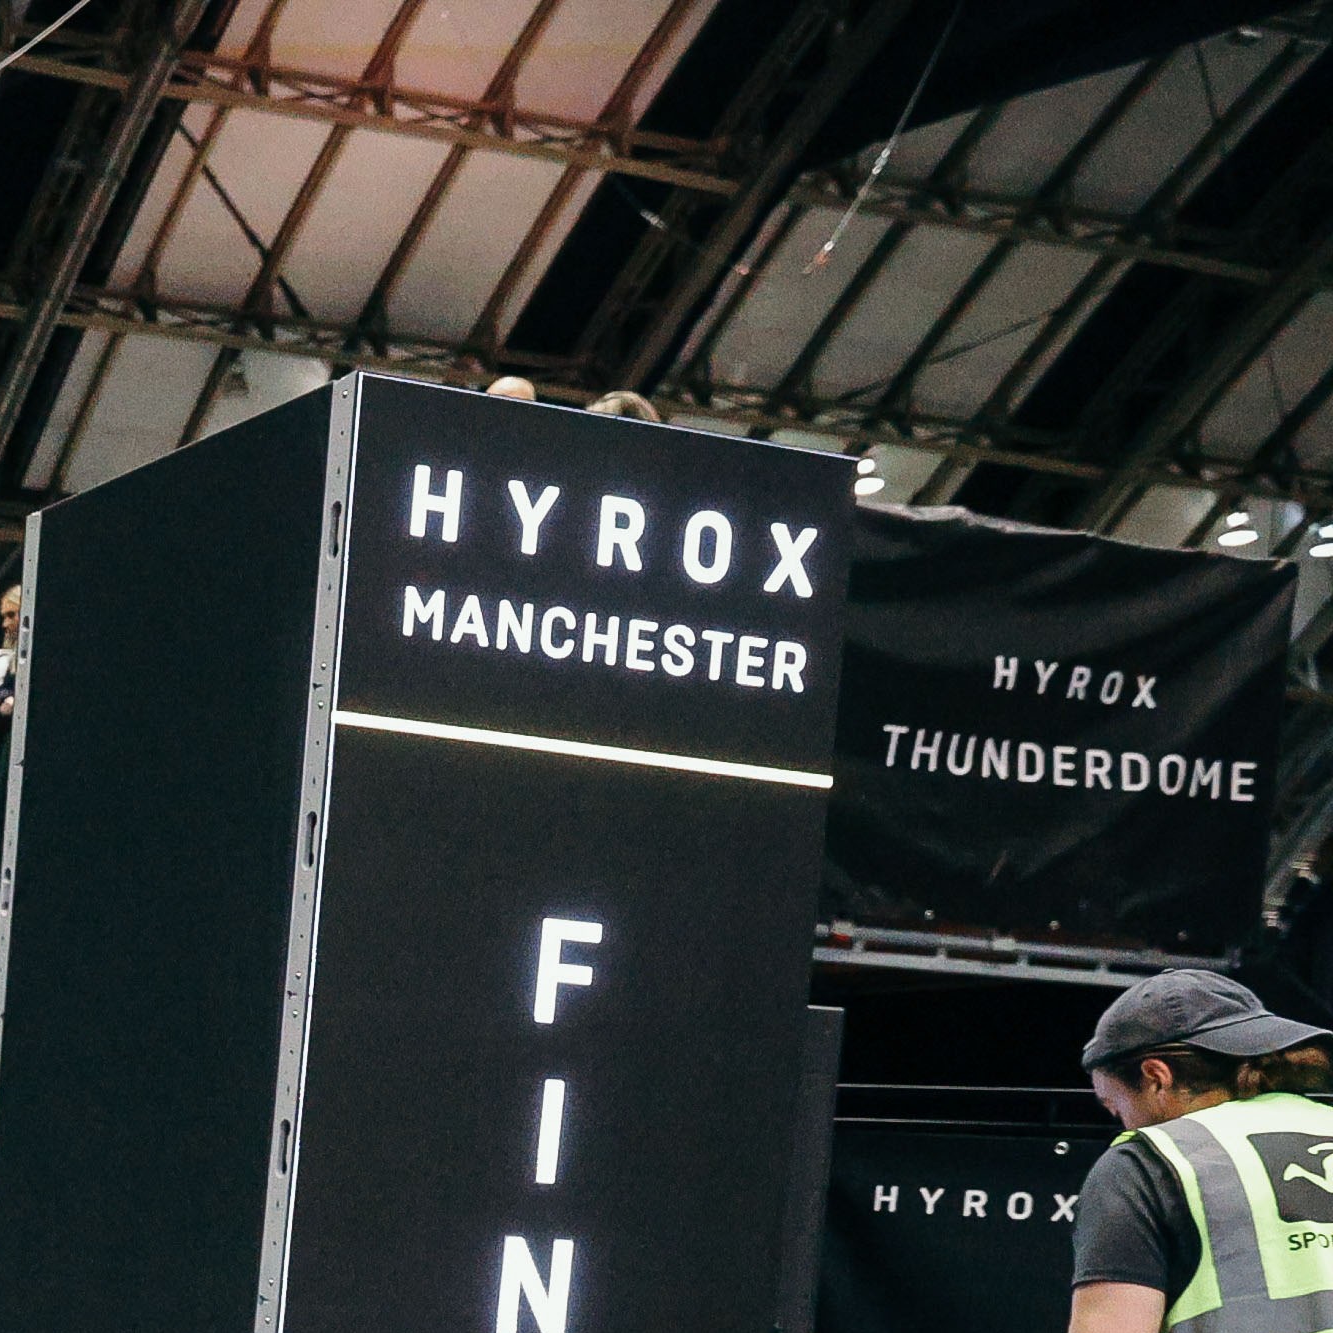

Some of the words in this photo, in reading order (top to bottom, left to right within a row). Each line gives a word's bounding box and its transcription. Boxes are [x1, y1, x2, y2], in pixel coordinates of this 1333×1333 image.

[408, 463, 821, 600] HYROX
[401, 585, 808, 694] MANCHESTER
[993, 655, 1157, 709] HYROX
[883, 724, 1257, 802] THUNDERDOME
[874, 1185, 1077, 1223] HYROX
[1287, 1232, 1333, 1251] SPO
